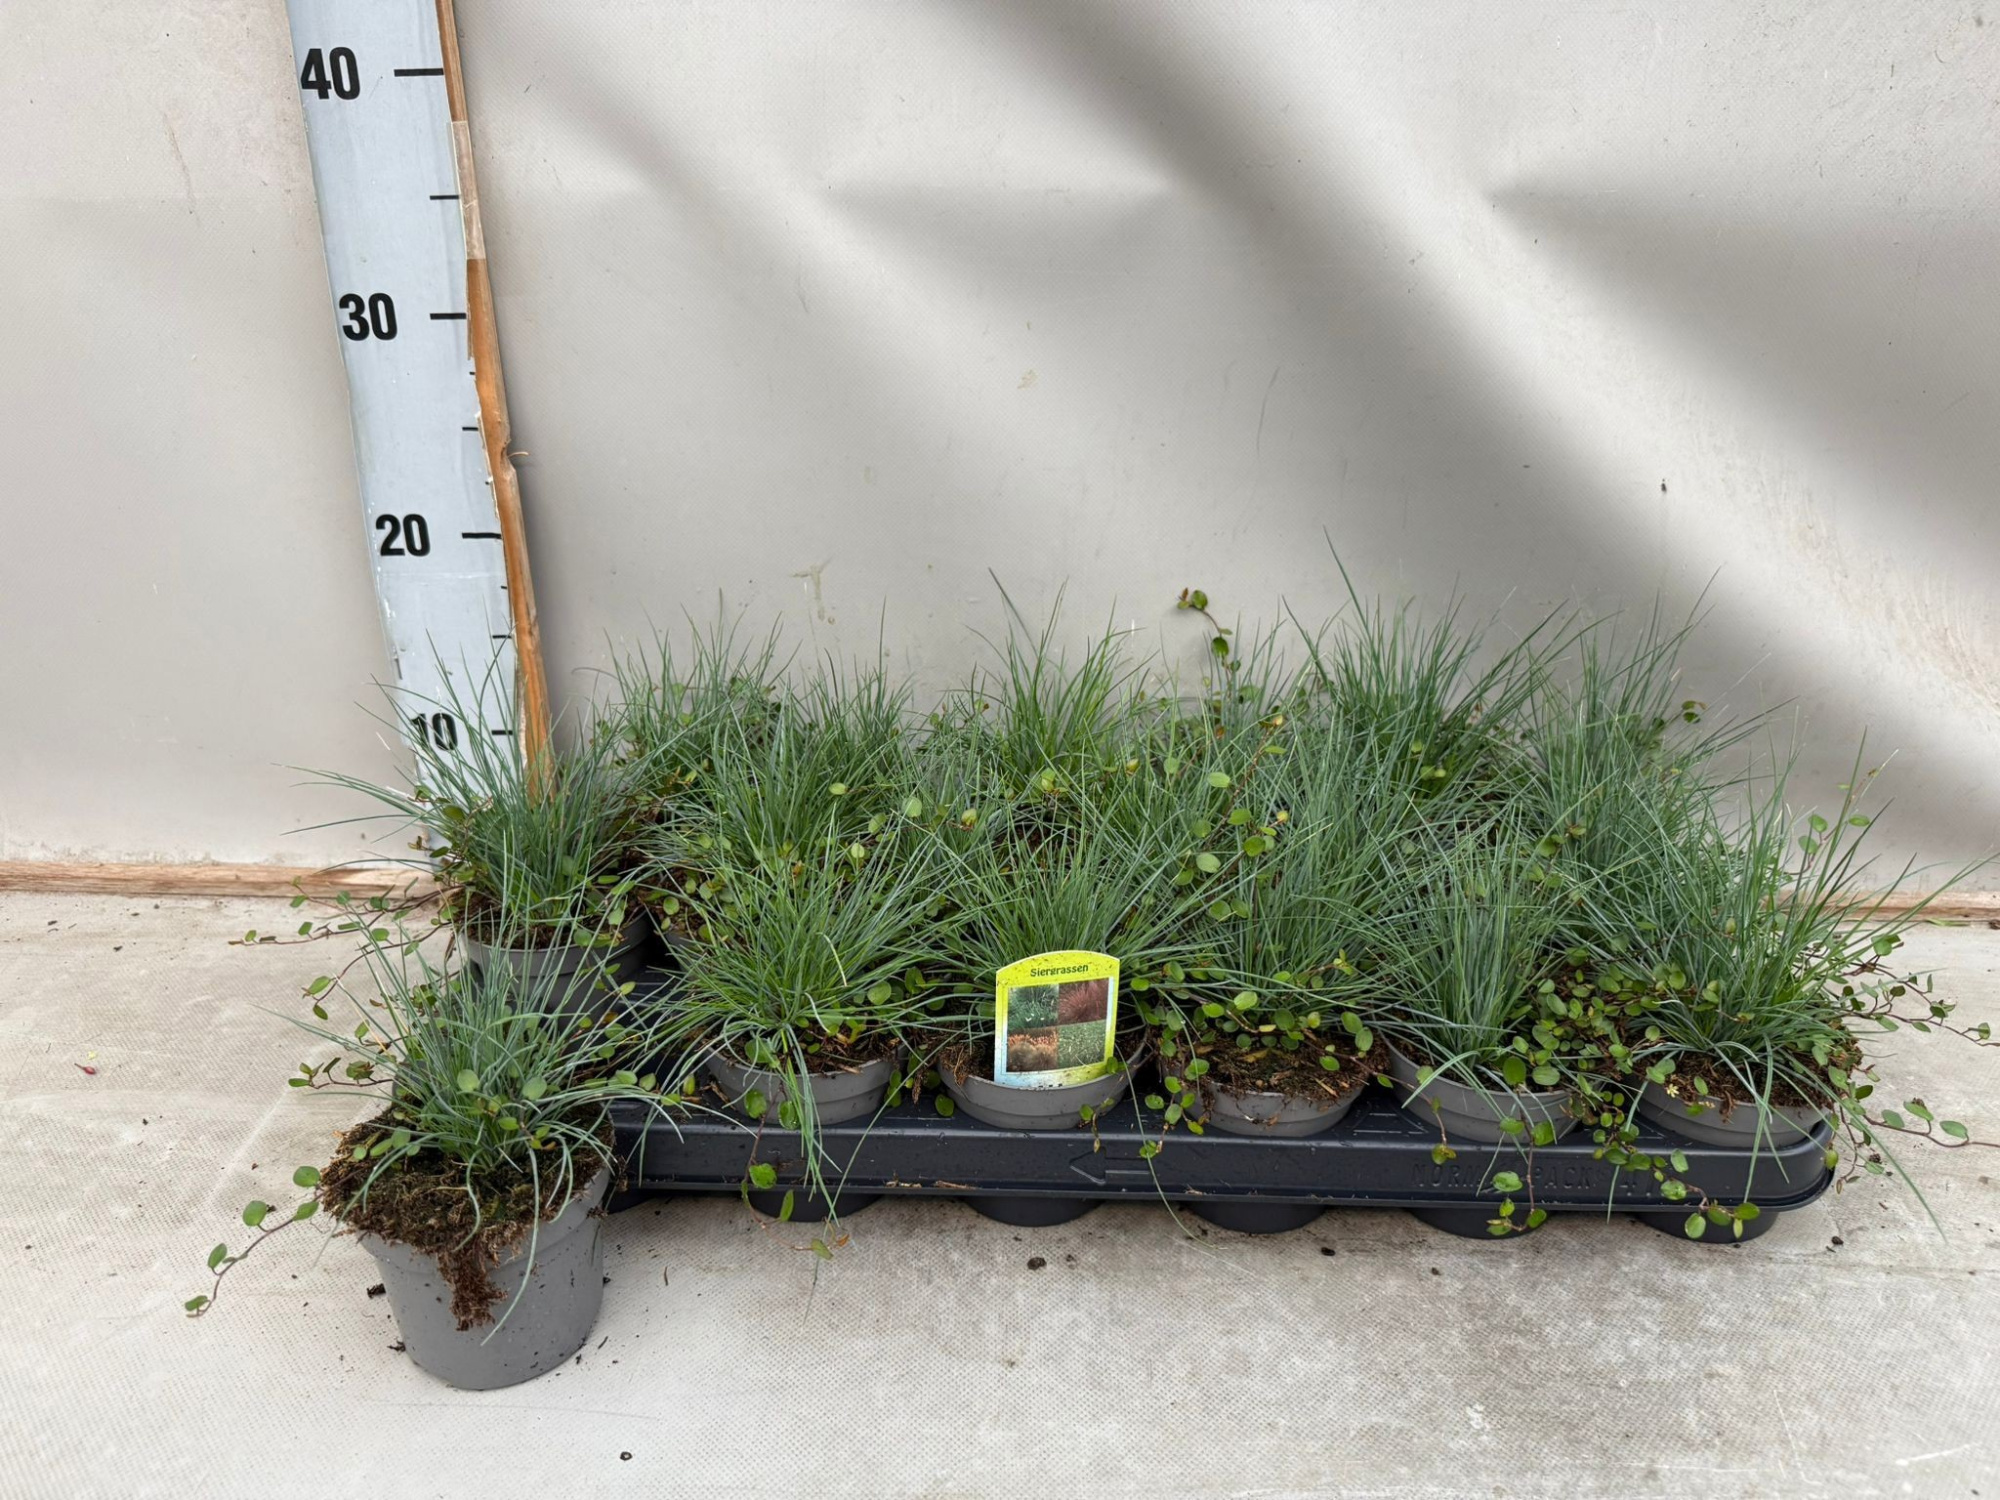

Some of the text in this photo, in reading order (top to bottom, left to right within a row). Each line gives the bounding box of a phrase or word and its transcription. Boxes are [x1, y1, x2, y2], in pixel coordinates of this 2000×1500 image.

[300, 46, 361, 101] 40
[338, 292, 398, 341] 30
[375, 513, 431, 557] 20
[410, 712, 458, 751] 10
[1030, 963, 1089, 978] Siergrassen
